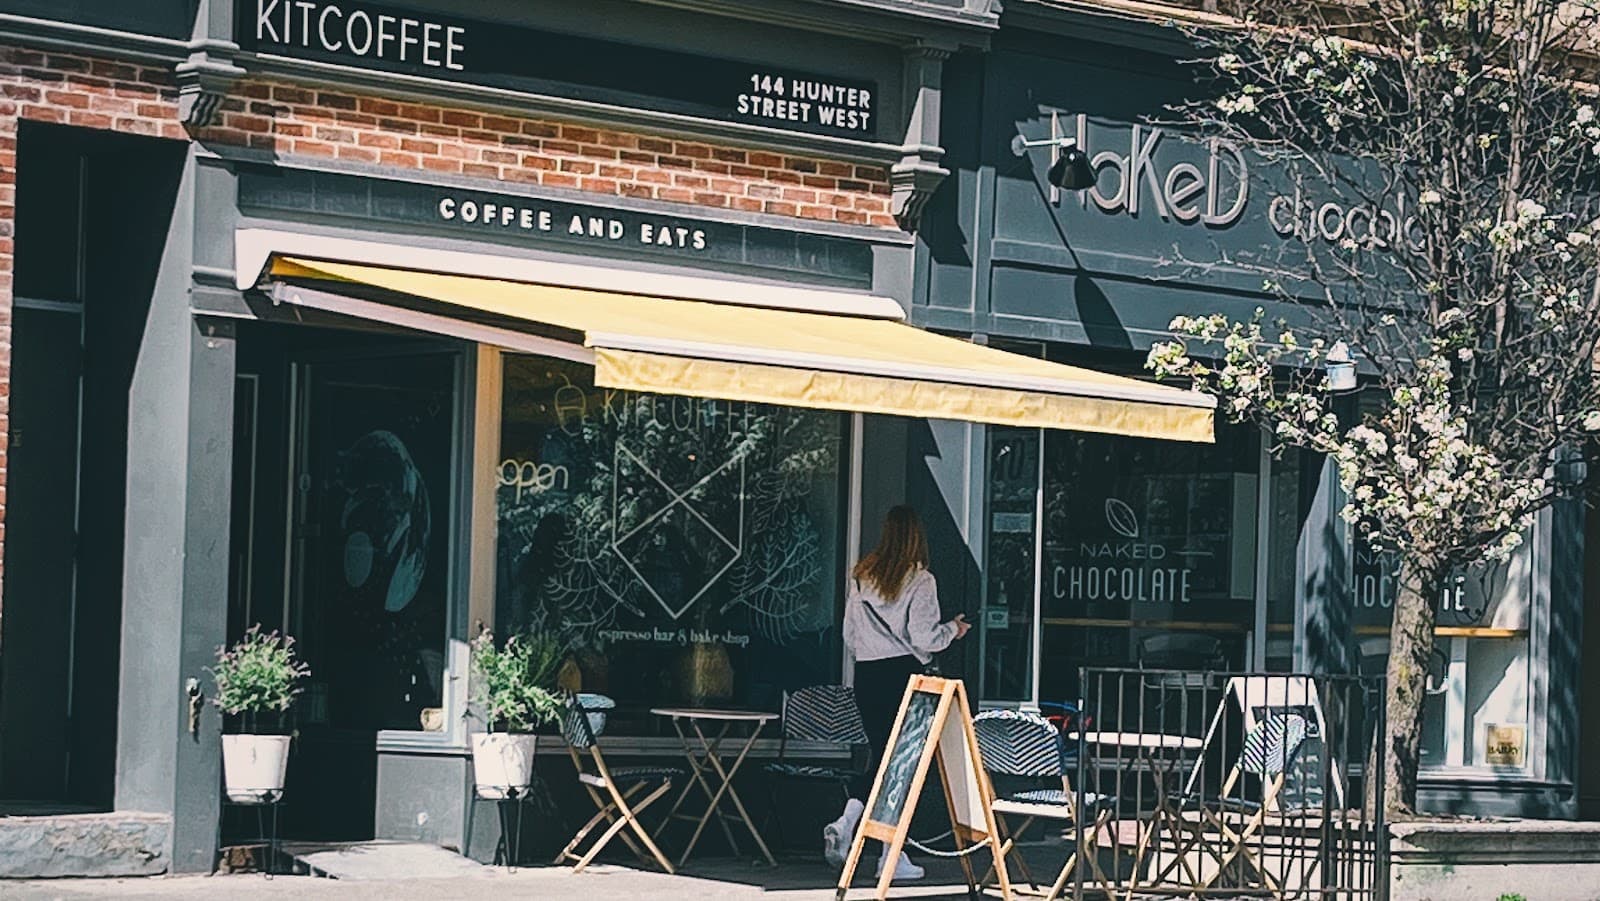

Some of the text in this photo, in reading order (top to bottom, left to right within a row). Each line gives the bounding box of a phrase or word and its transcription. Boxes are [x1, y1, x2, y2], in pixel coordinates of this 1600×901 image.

[256, 0, 465, 71] KITCOFFEE
[750, 74, 870, 109] 144 HUNTER
[737, 94, 870, 130] STREET WEST
[439, 198, 706, 250] COFFEE AND EATS
[501, 459, 569, 505] open
[1080, 542, 1166, 560] NAKED
[1054, 565, 1191, 602] CHOCOLATE
[598, 630, 652, 643] espresso
[654, 627, 675, 642] bar
